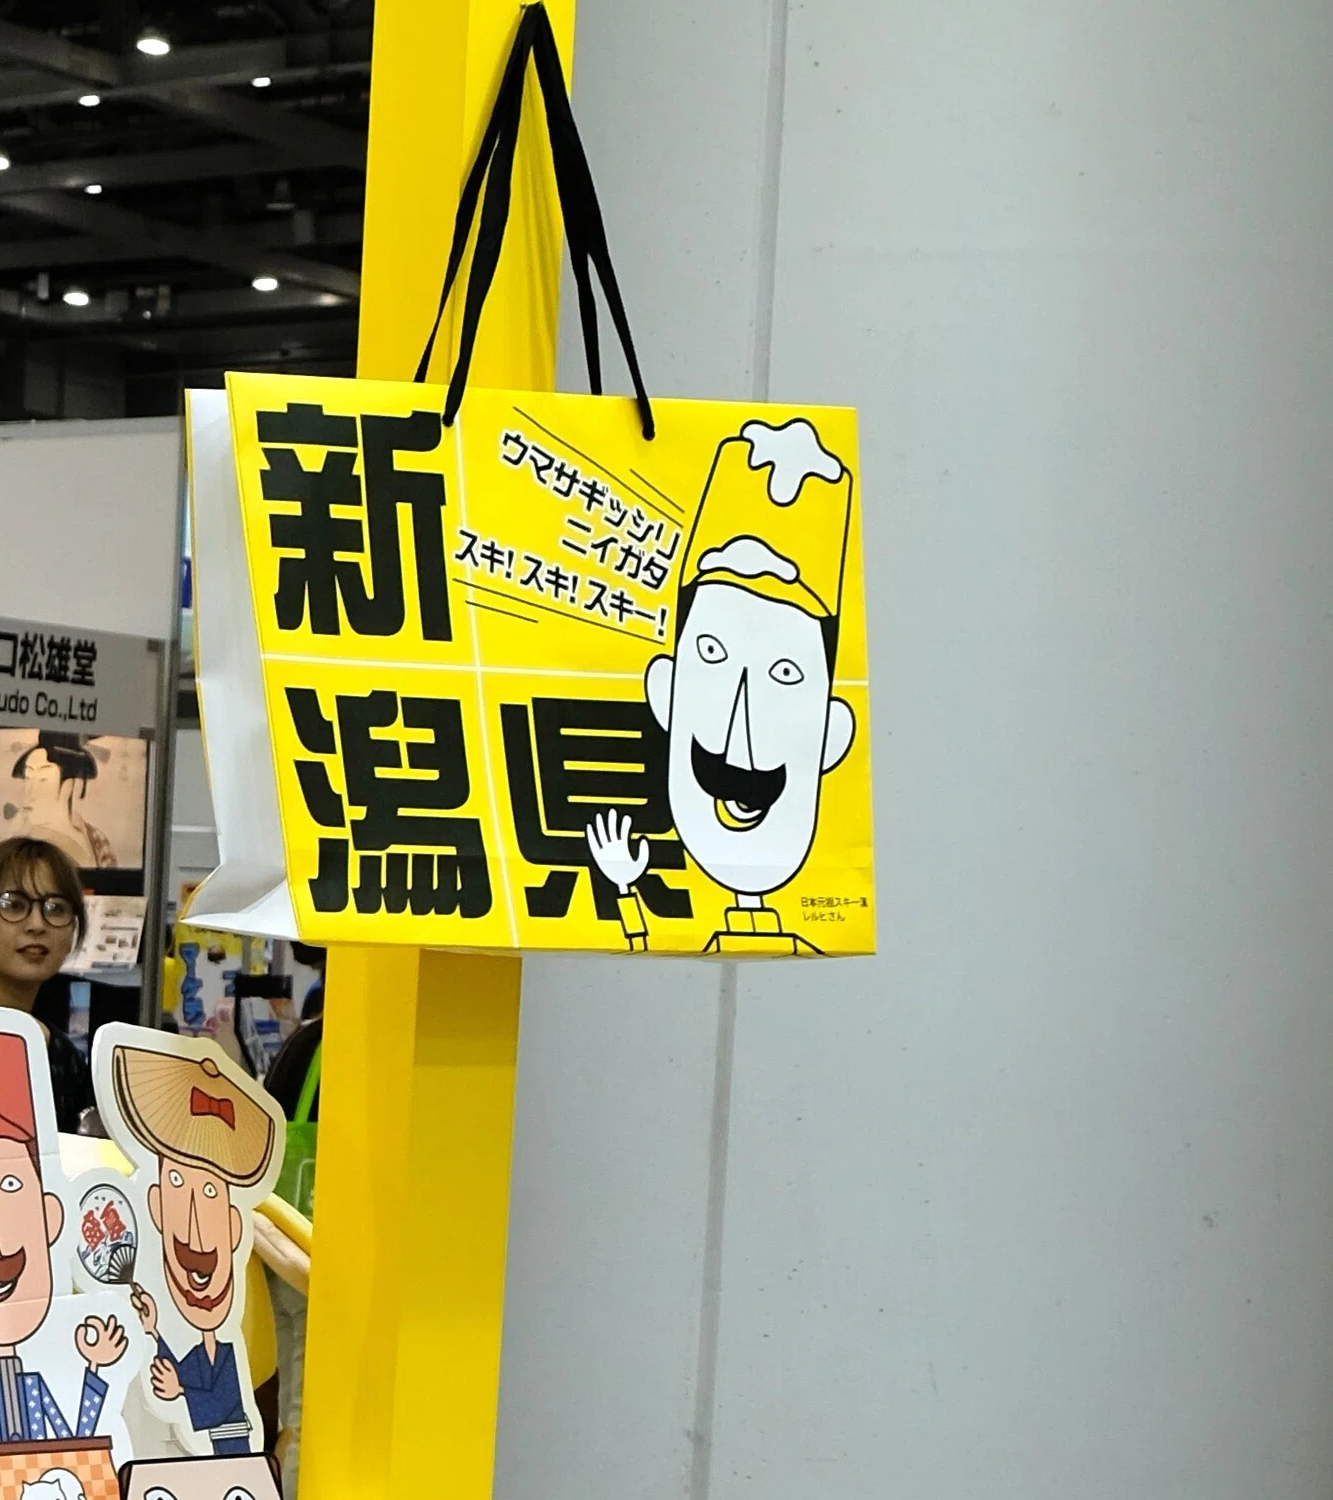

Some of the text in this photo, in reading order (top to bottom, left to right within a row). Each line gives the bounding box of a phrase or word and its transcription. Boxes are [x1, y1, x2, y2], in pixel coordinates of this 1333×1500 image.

[499, 429, 685, 560] ウマサギッシリ
[560, 518, 671, 590] ニイガタ
[33, 692, 98, 725] Co.,Ltd
